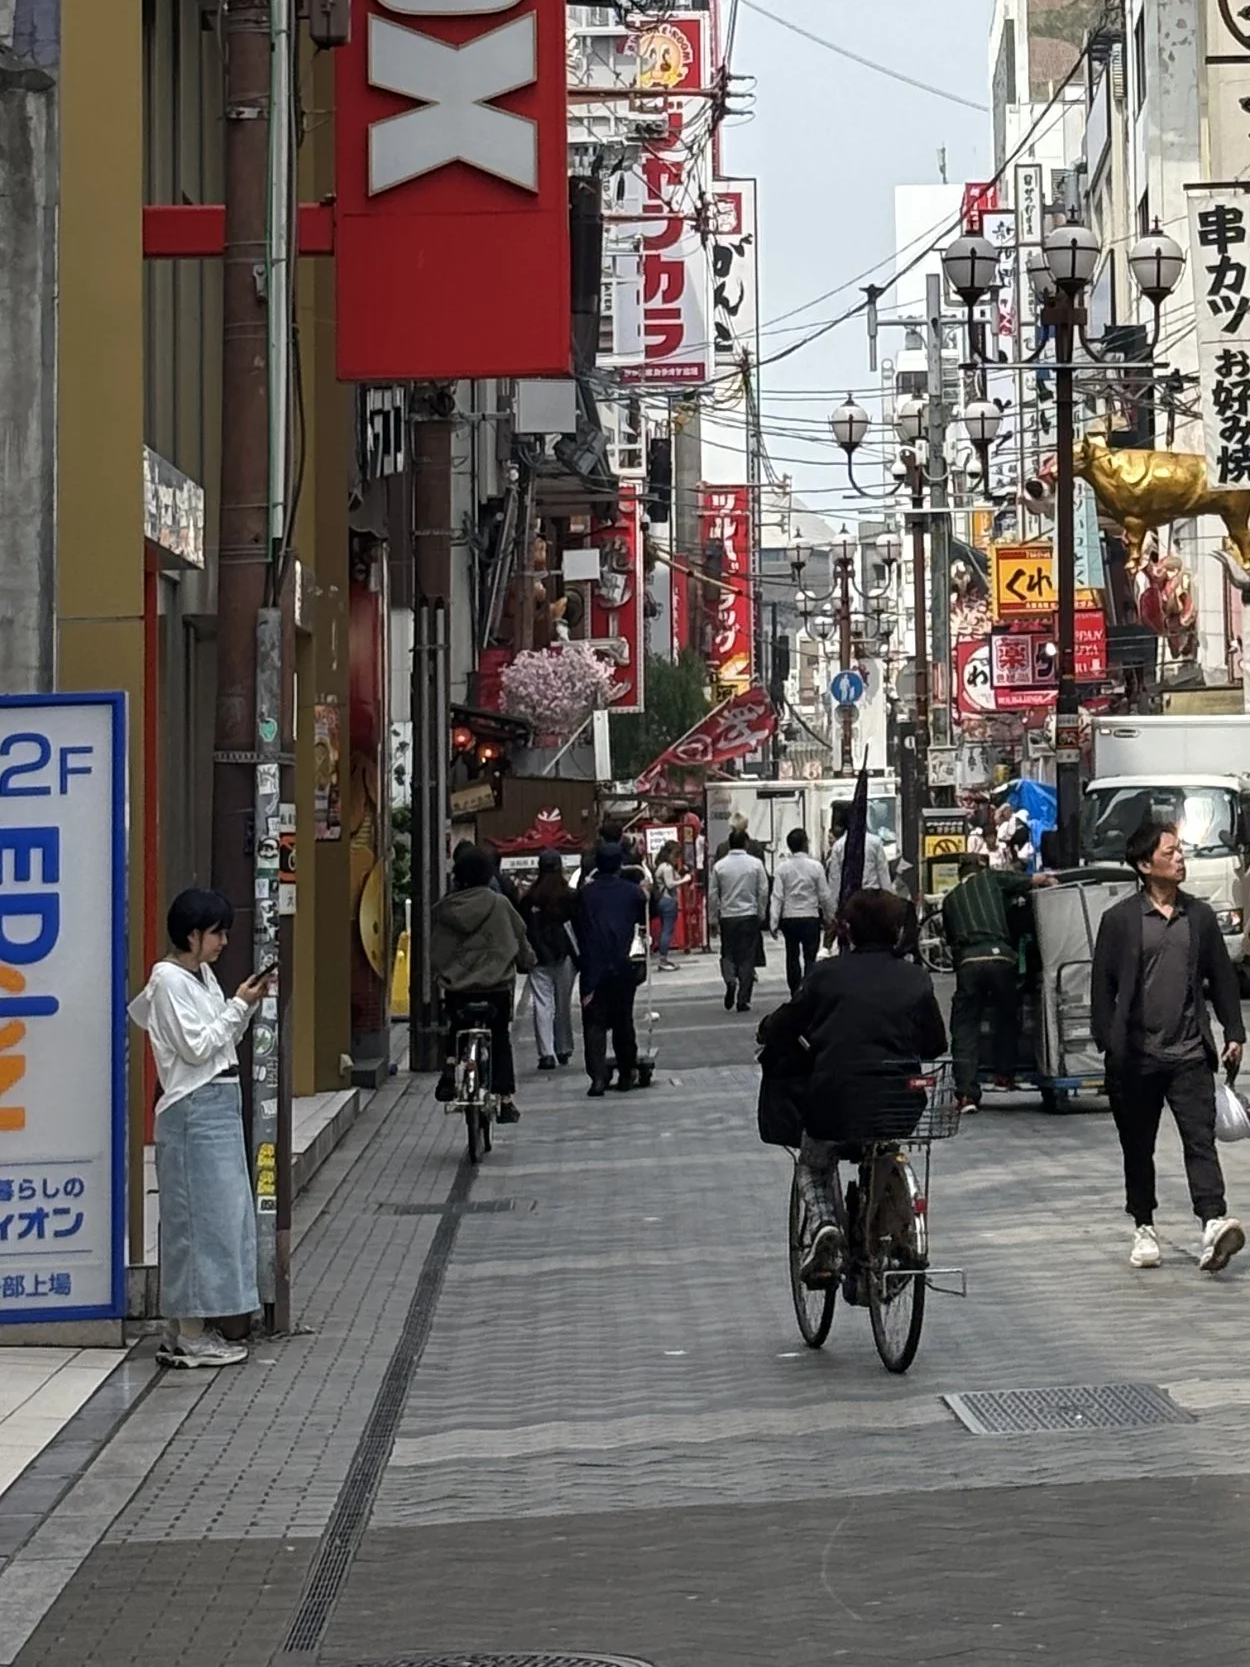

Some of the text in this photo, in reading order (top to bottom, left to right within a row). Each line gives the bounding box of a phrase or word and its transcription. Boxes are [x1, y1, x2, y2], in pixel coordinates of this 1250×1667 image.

[1198, 204, 1250, 334] 串カツ
[0, 732, 93, 797] 2F
[0, 1272, 72, 1299] 部上場
